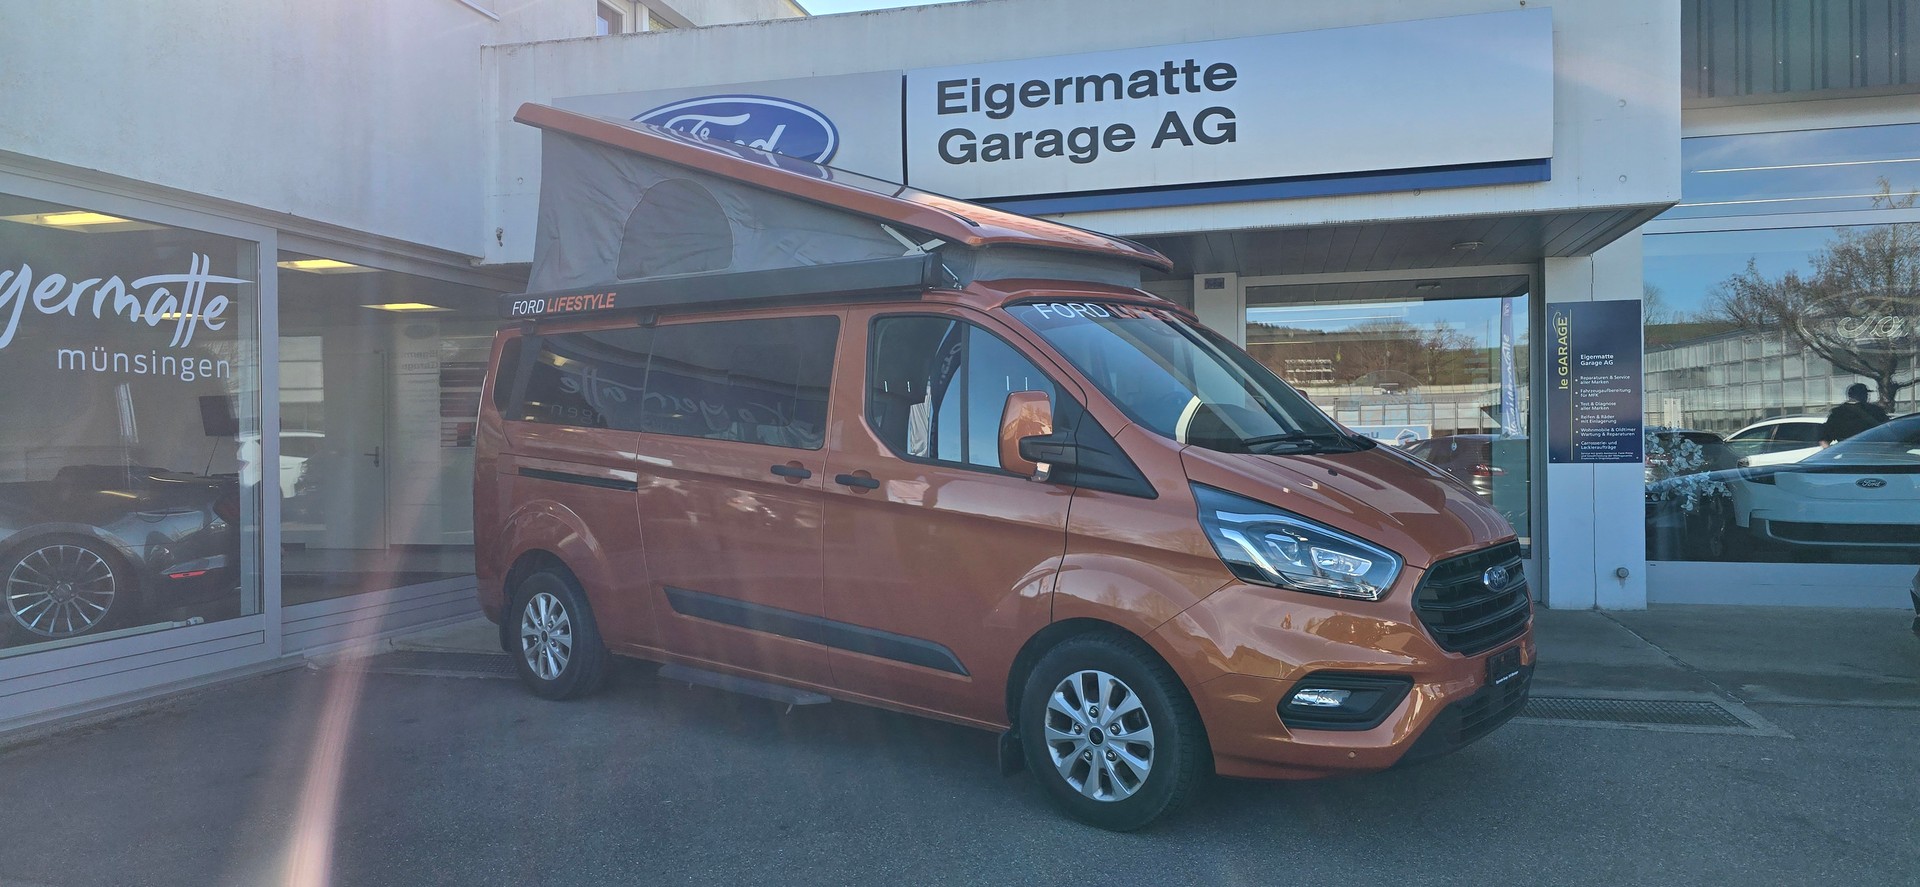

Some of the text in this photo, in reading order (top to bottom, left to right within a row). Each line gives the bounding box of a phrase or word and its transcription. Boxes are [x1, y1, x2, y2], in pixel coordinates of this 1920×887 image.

[936, 60, 1239, 121] Eigermatte
[936, 106, 1239, 166] Garage AG
[511, 291, 617, 316] FORD LIFESTYLE
[1032, 302, 1111, 320] FORD
[57, 346, 231, 382] münsingen
[1558, 317, 1569, 389] le GARAGE
